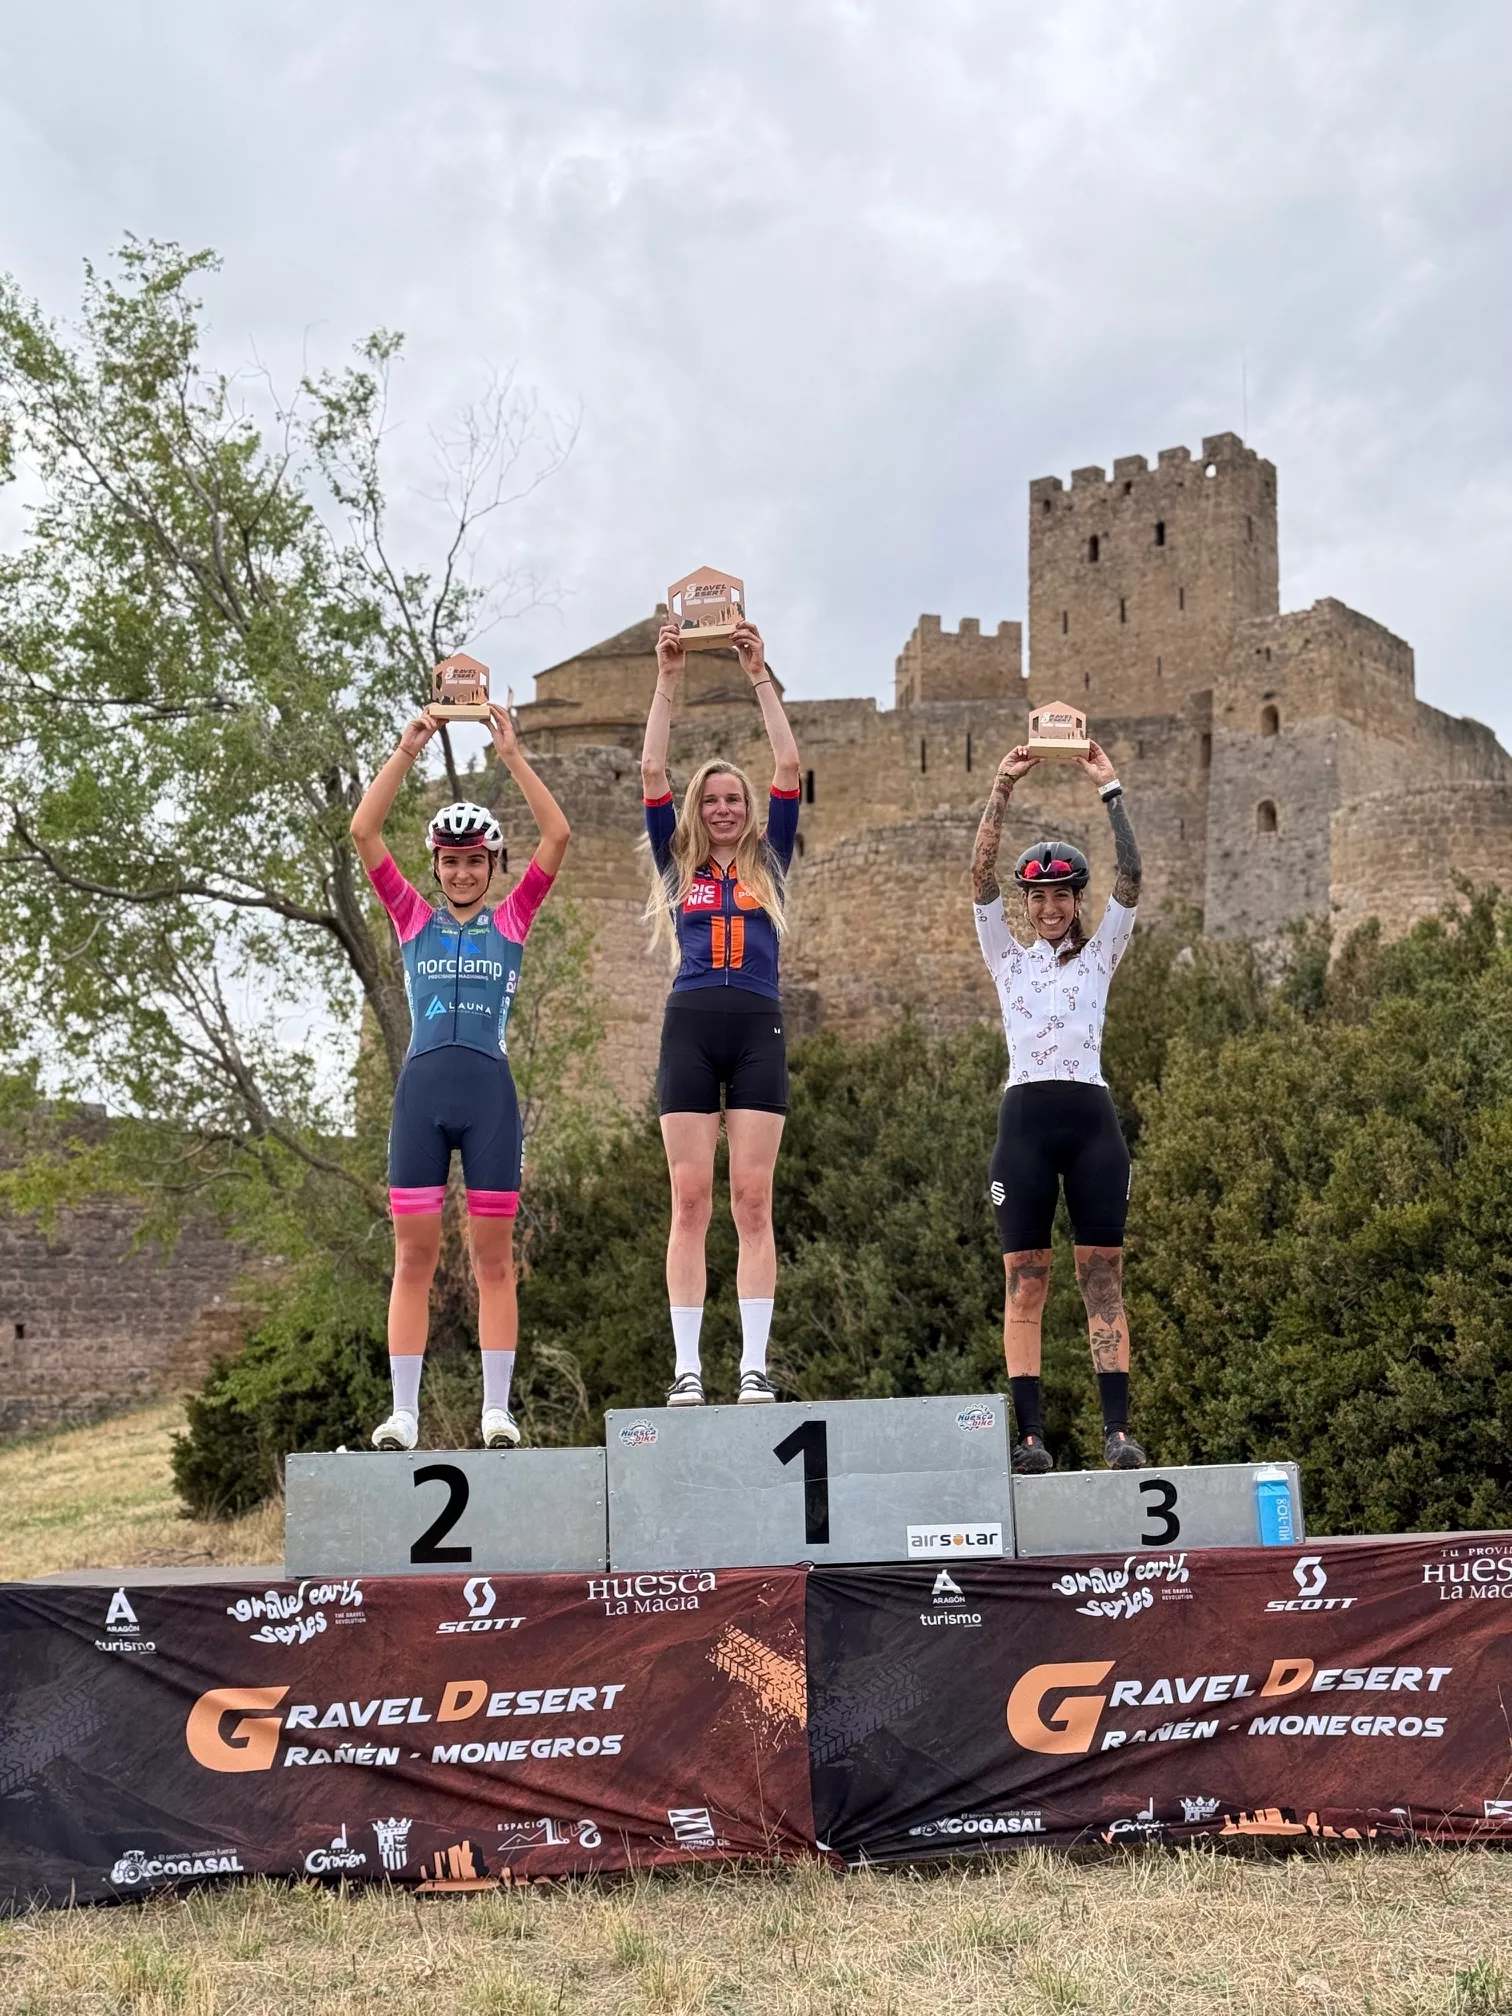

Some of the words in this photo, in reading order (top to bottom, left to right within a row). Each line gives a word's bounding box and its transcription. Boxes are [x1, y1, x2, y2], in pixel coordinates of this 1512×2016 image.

[417, 956, 502, 981] norclamp
[449, 1002, 492, 1014] LAUNA
[772, 1420, 830, 1545] 1
[410, 1464, 472, 1564] 2
[1139, 1479, 1181, 1546] 3
[1134, 1553, 1190, 1583] earth
[309, 1579, 363, 1606] earth
[932, 1595, 965, 1604] ARAGÓN
[1075, 1587, 1154, 1619] series
[1264, 1598, 1357, 1611] SCOTT
[106, 1624, 140, 1632] ARAGÓN
[250, 1611, 327, 1645] series
[436, 1617, 526, 1634] SCOTT
[920, 1611, 982, 1626] turismo
[94, 1638, 156, 1652] turismo
[1260, 1658, 1452, 1697] DESERT
[436, 1679, 626, 1723] DESERT
[1248, 1716, 1448, 1738] MONEGROS
[432, 1734, 625, 1764] MONEGROS
[946, 1818, 1046, 1834] COGASAL
[147, 1856, 244, 1876] COGASAL
[305, 1848, 366, 1873] Grañén
